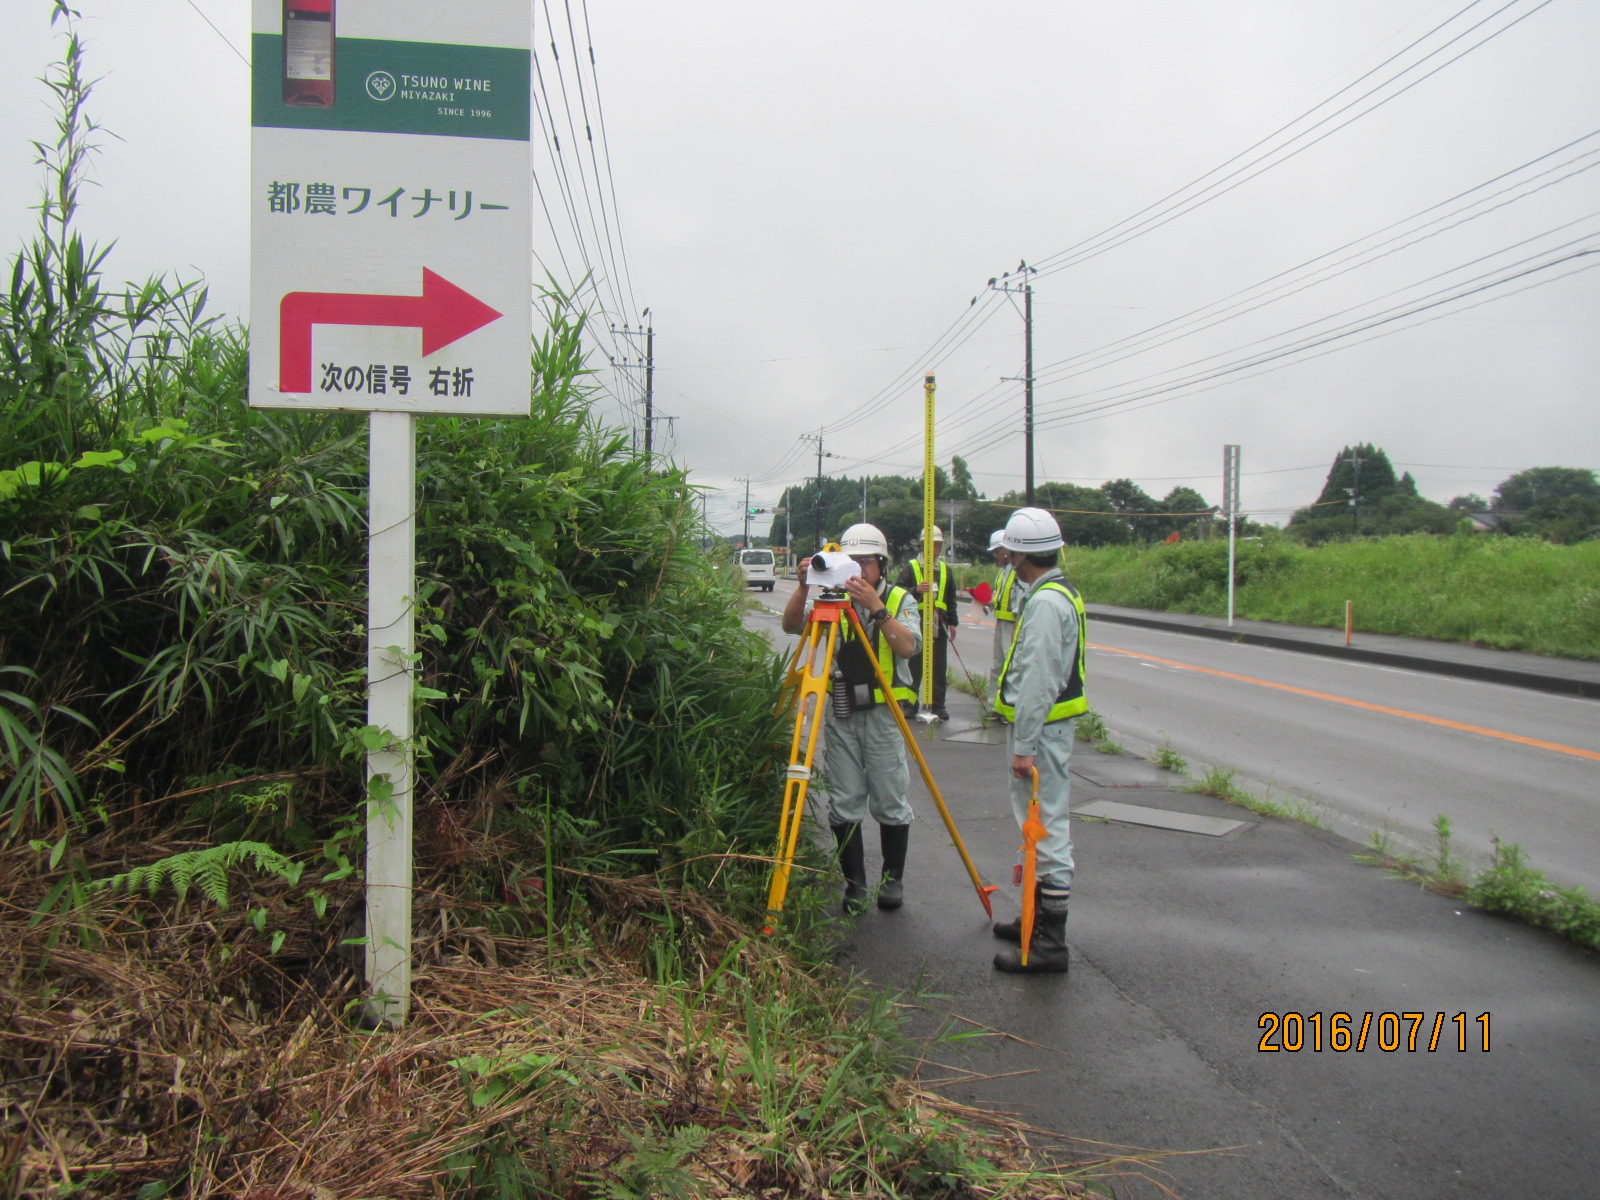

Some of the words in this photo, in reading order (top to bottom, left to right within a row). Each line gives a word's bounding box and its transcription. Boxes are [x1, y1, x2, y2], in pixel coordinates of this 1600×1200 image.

[401, 75, 448, 89] TSUNO
[454, 78, 491, 92] WINE
[401, 90, 455, 102] MIYAZAKI
[437, 107, 465, 117] SINCE
[470, 109, 492, 118] 1996
[267, 180, 510, 221] 都農ワイナリー
[320, 362, 412, 395] 次の信号
[428, 366, 475, 397] 右折
